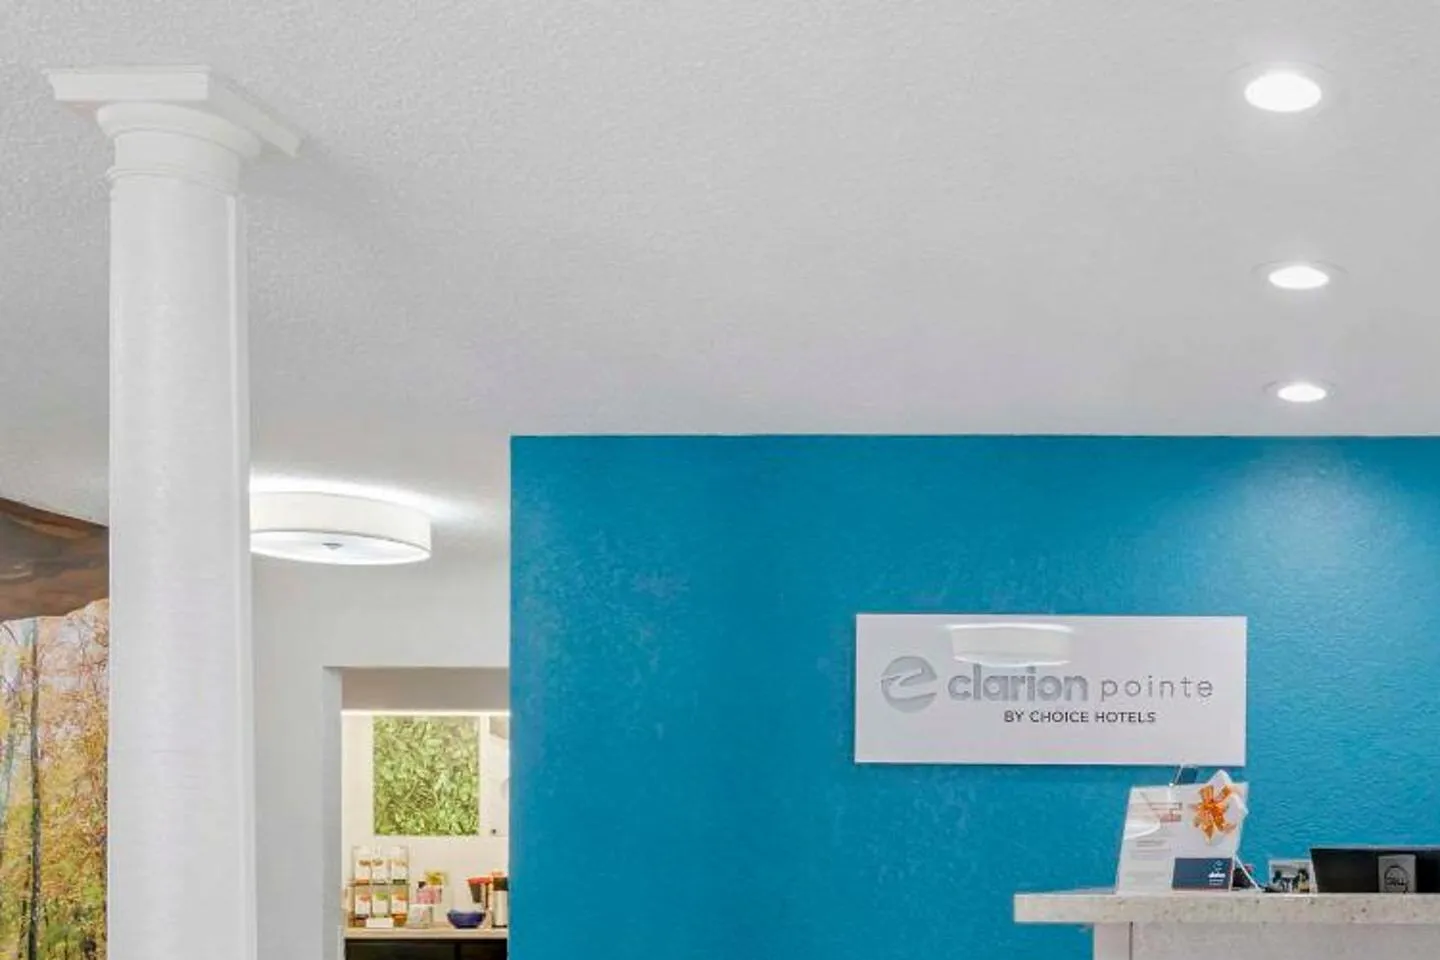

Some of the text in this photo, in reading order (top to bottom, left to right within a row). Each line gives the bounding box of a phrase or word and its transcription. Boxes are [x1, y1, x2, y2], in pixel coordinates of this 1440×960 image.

[947, 663, 1214, 701] clarion pointe
[1003, 711, 1156, 724] BY CHOICE HOTELS
